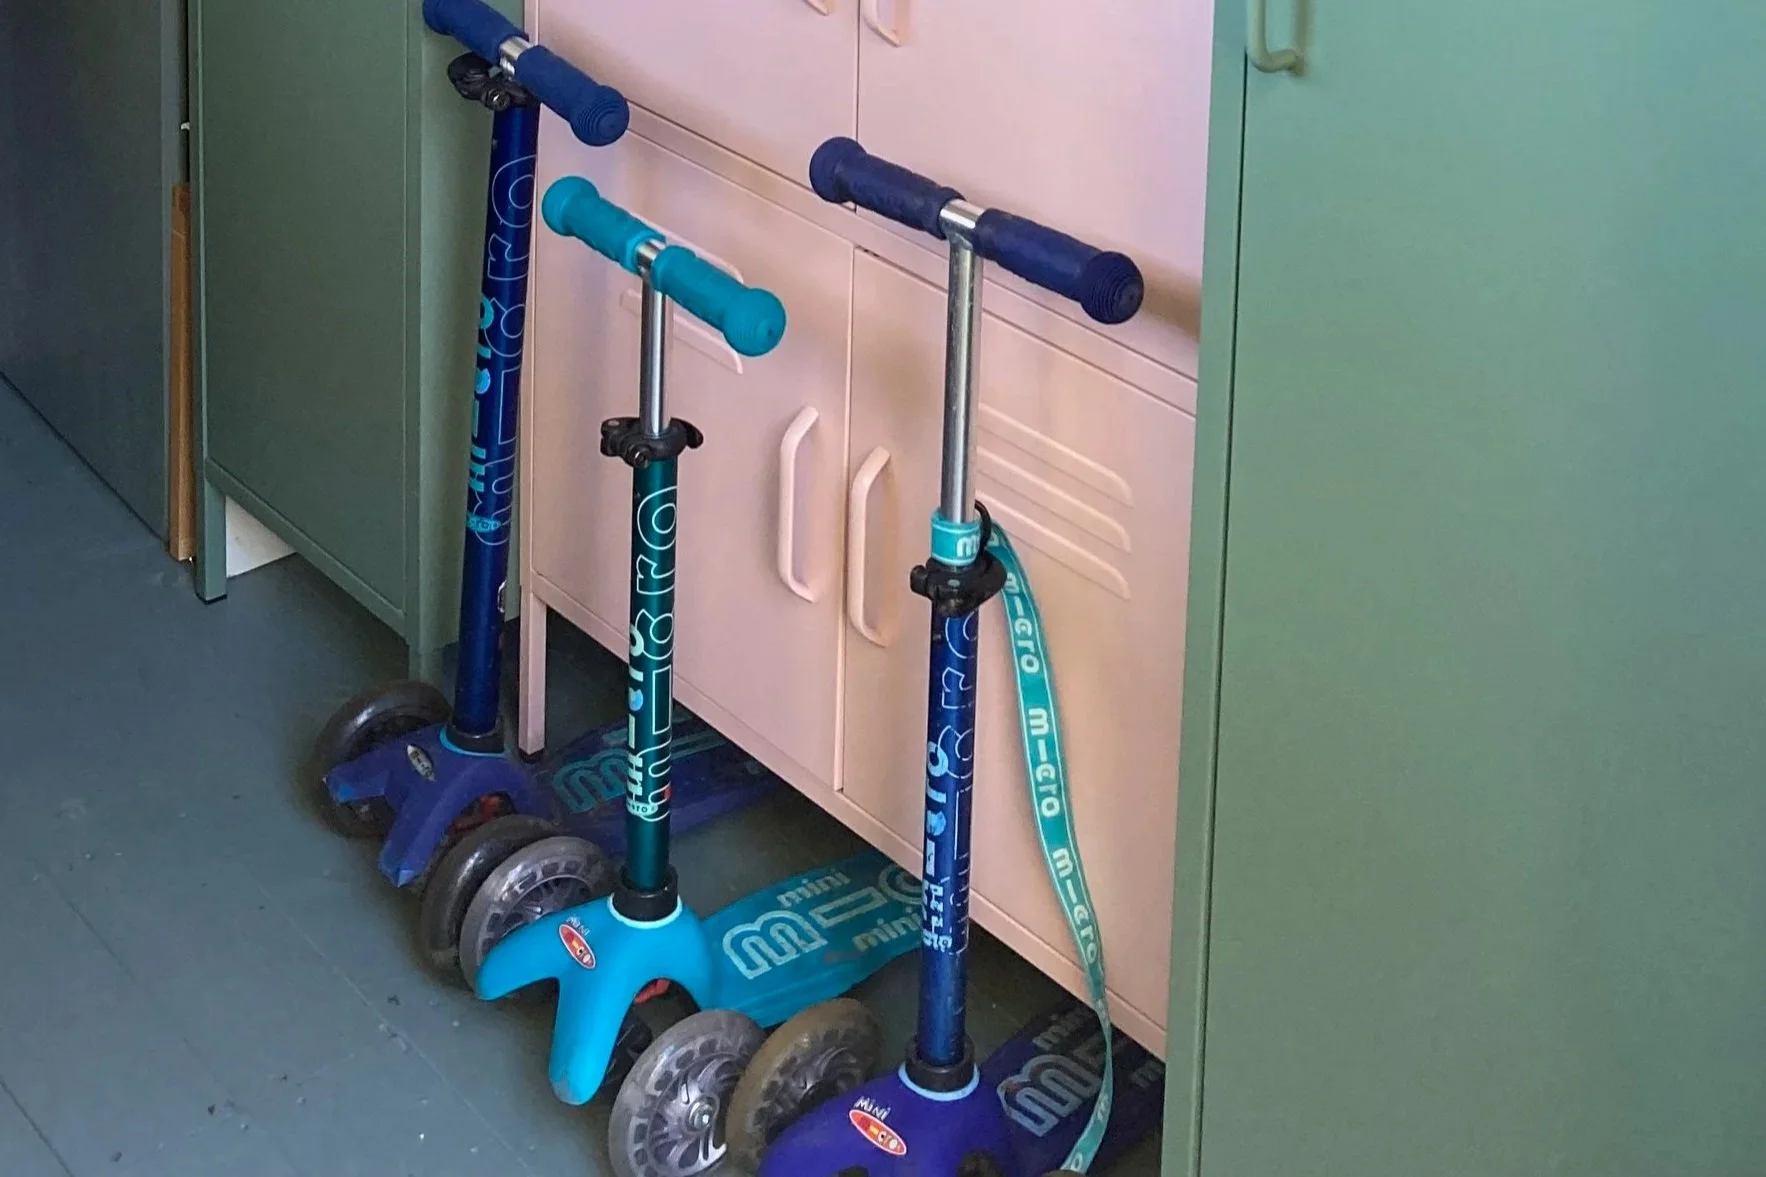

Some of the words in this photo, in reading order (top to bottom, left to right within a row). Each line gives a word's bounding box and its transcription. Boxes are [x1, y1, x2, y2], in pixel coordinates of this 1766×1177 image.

[1003, 571, 1040, 674] micro
[1028, 706, 1061, 818] micro
[777, 868, 851, 909] mini
[1052, 847, 1097, 964] micro
